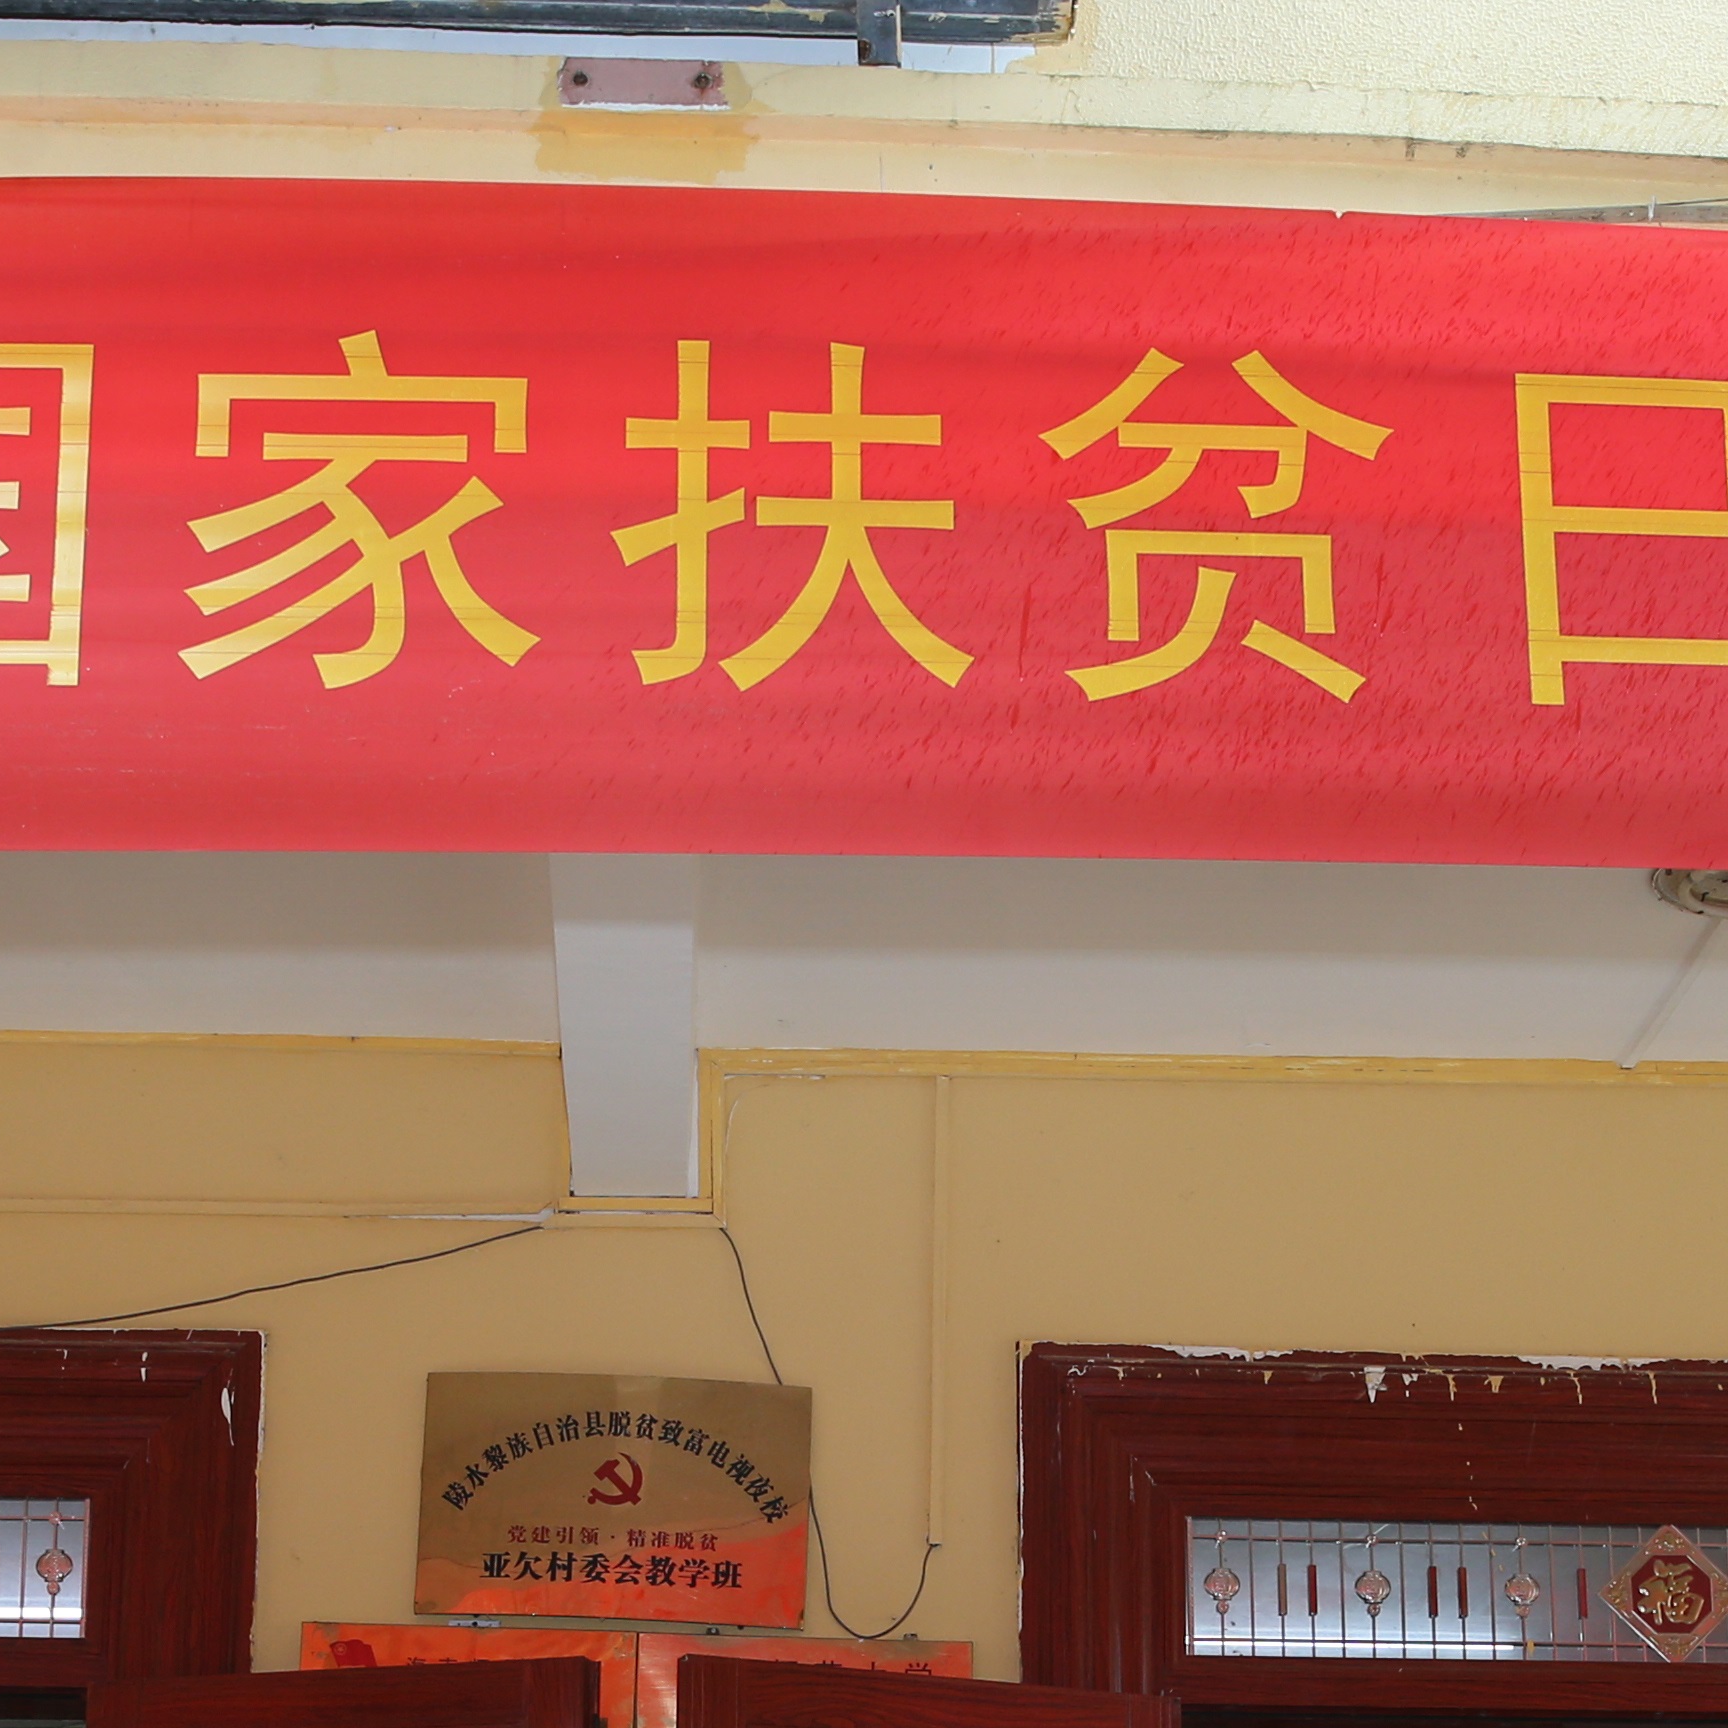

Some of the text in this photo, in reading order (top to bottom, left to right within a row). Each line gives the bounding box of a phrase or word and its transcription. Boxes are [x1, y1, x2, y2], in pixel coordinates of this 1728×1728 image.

[441, 1410, 788, 1524] 陵水黎族自治县脱贫致富电视夜校
[480, 1551, 743, 1589] 亚欠村委会教学班
